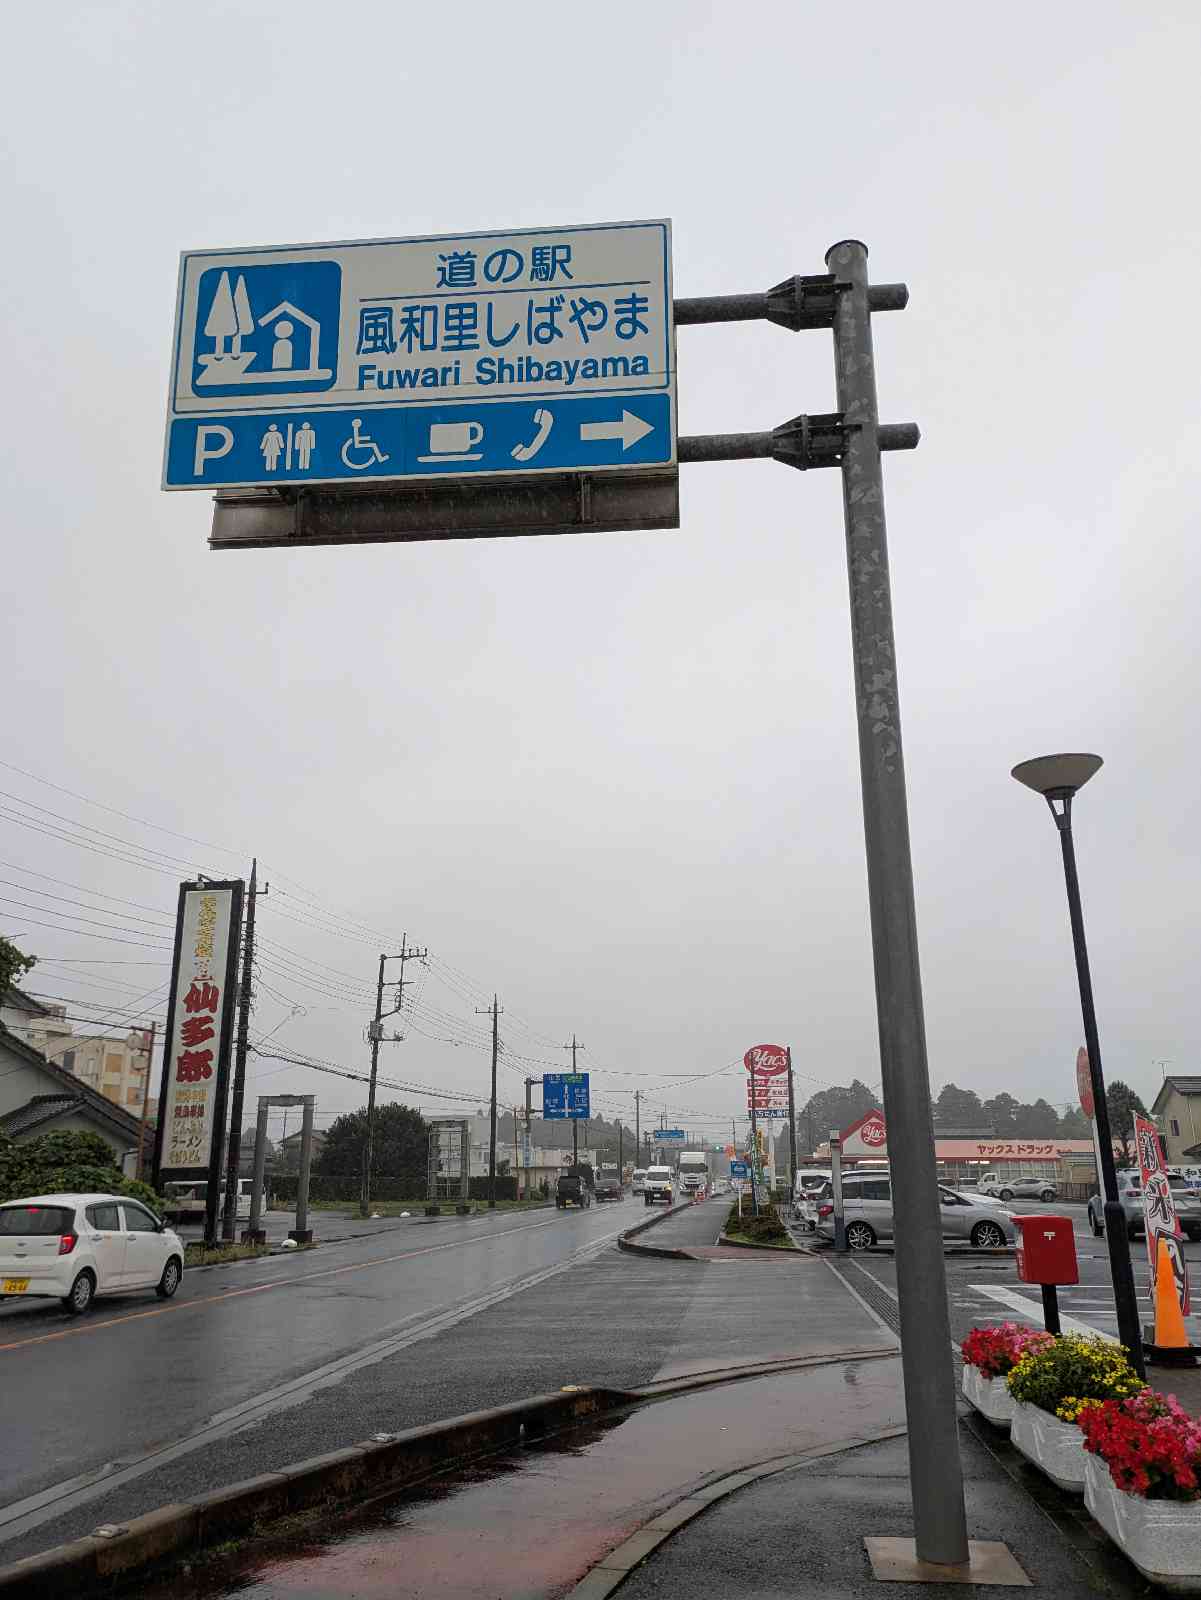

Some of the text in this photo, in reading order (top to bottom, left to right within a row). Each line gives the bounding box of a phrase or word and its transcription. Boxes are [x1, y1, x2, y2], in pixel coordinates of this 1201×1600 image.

[436, 244, 574, 288] 道の駅
[356, 291, 649, 355] 風和里しばやま
[357, 355, 649, 391] Fuwari Shibayama
[193, 424, 234, 476] P
